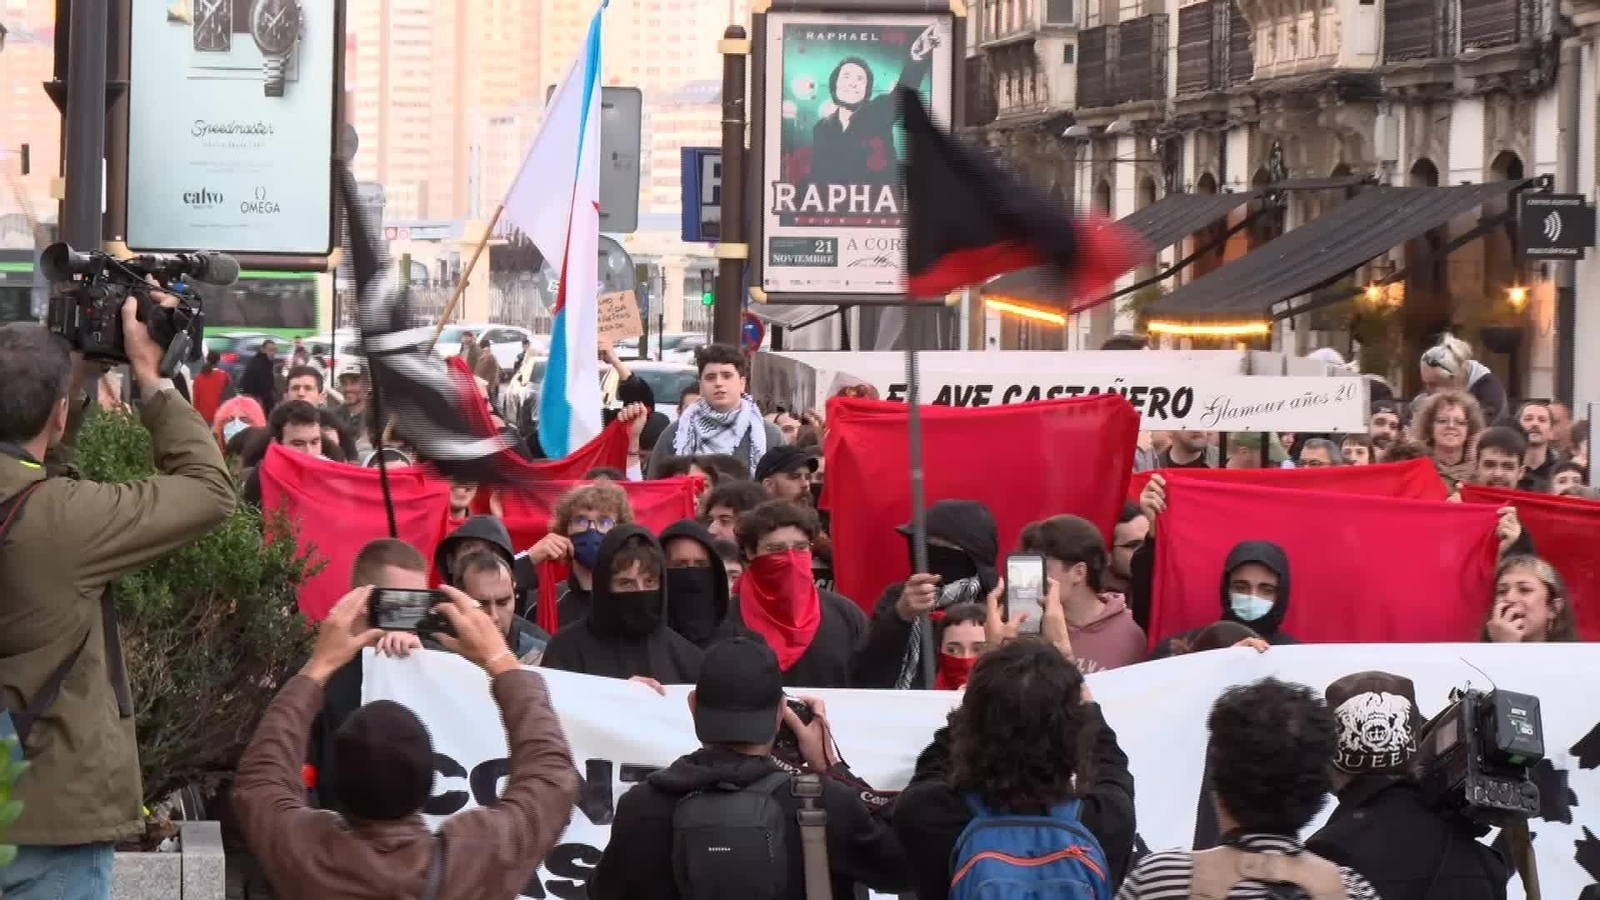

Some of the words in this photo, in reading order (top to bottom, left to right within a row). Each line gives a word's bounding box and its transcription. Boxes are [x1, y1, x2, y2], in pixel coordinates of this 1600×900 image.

[806, 31, 879, 41] RAPHAEL
[191, 119, 274, 137] Speedmaster
[183, 187, 223, 204] calvo
[774, 183, 904, 214] RAPHA
[240, 201, 281, 214] OMEGA
[815, 239, 833, 254] 21
[846, 238, 859, 251] A
[865, 238, 904, 251] COR
[772, 254, 834, 264] NOVIEMBRE
[1001, 377, 1194, 420] CASERO
[1200, 393, 1286, 428] Glamour
[1289, 390, 1330, 410] años
